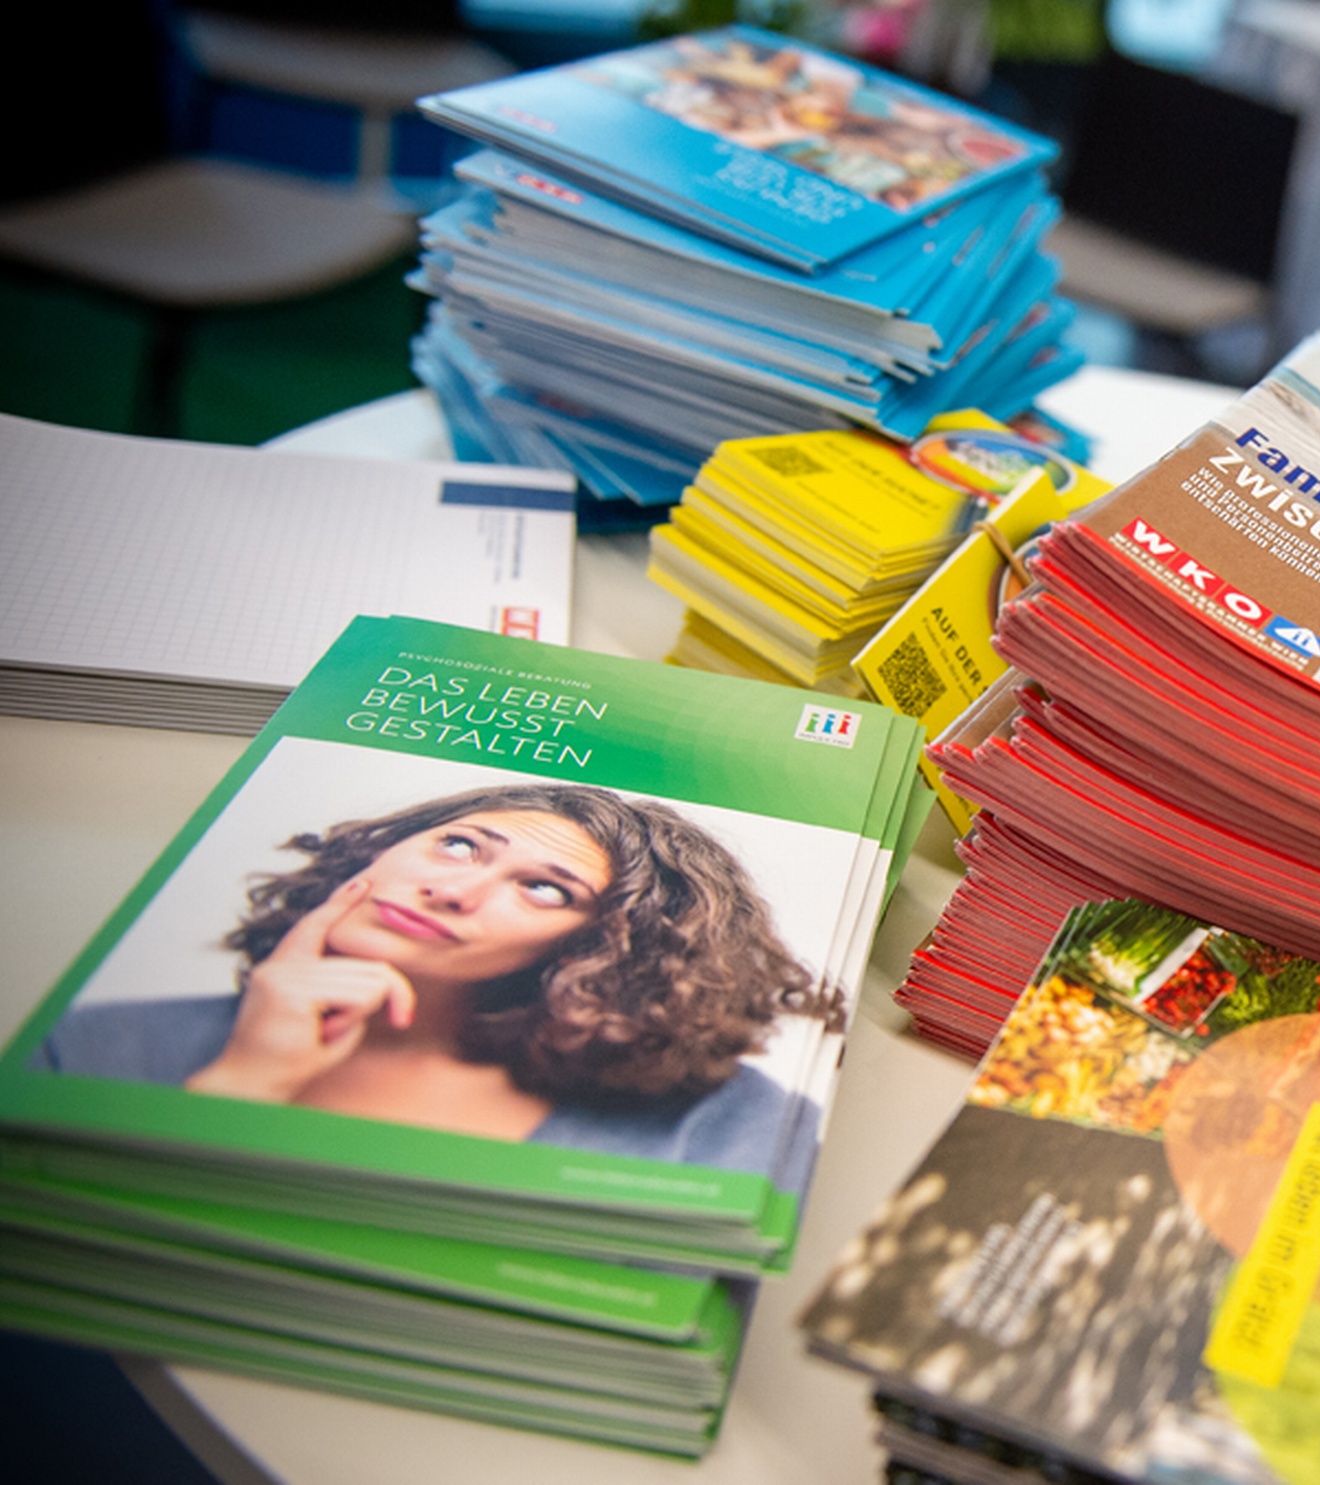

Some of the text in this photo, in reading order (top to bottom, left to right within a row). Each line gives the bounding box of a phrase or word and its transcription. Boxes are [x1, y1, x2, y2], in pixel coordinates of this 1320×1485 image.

[1189, 474, 1218, 497] und
[1198, 467, 1224, 491] Wie
[1132, 520, 1262, 620] WKO
[398, 652, 592, 690] PSYCHOSOZIALE BERATUNG
[931, 607, 982, 686] AUF DER
[361, 688, 576, 737] BEWUSST
[377, 666, 608, 720] DAS LEBEN
[346, 711, 592, 768] GESTALTEN
